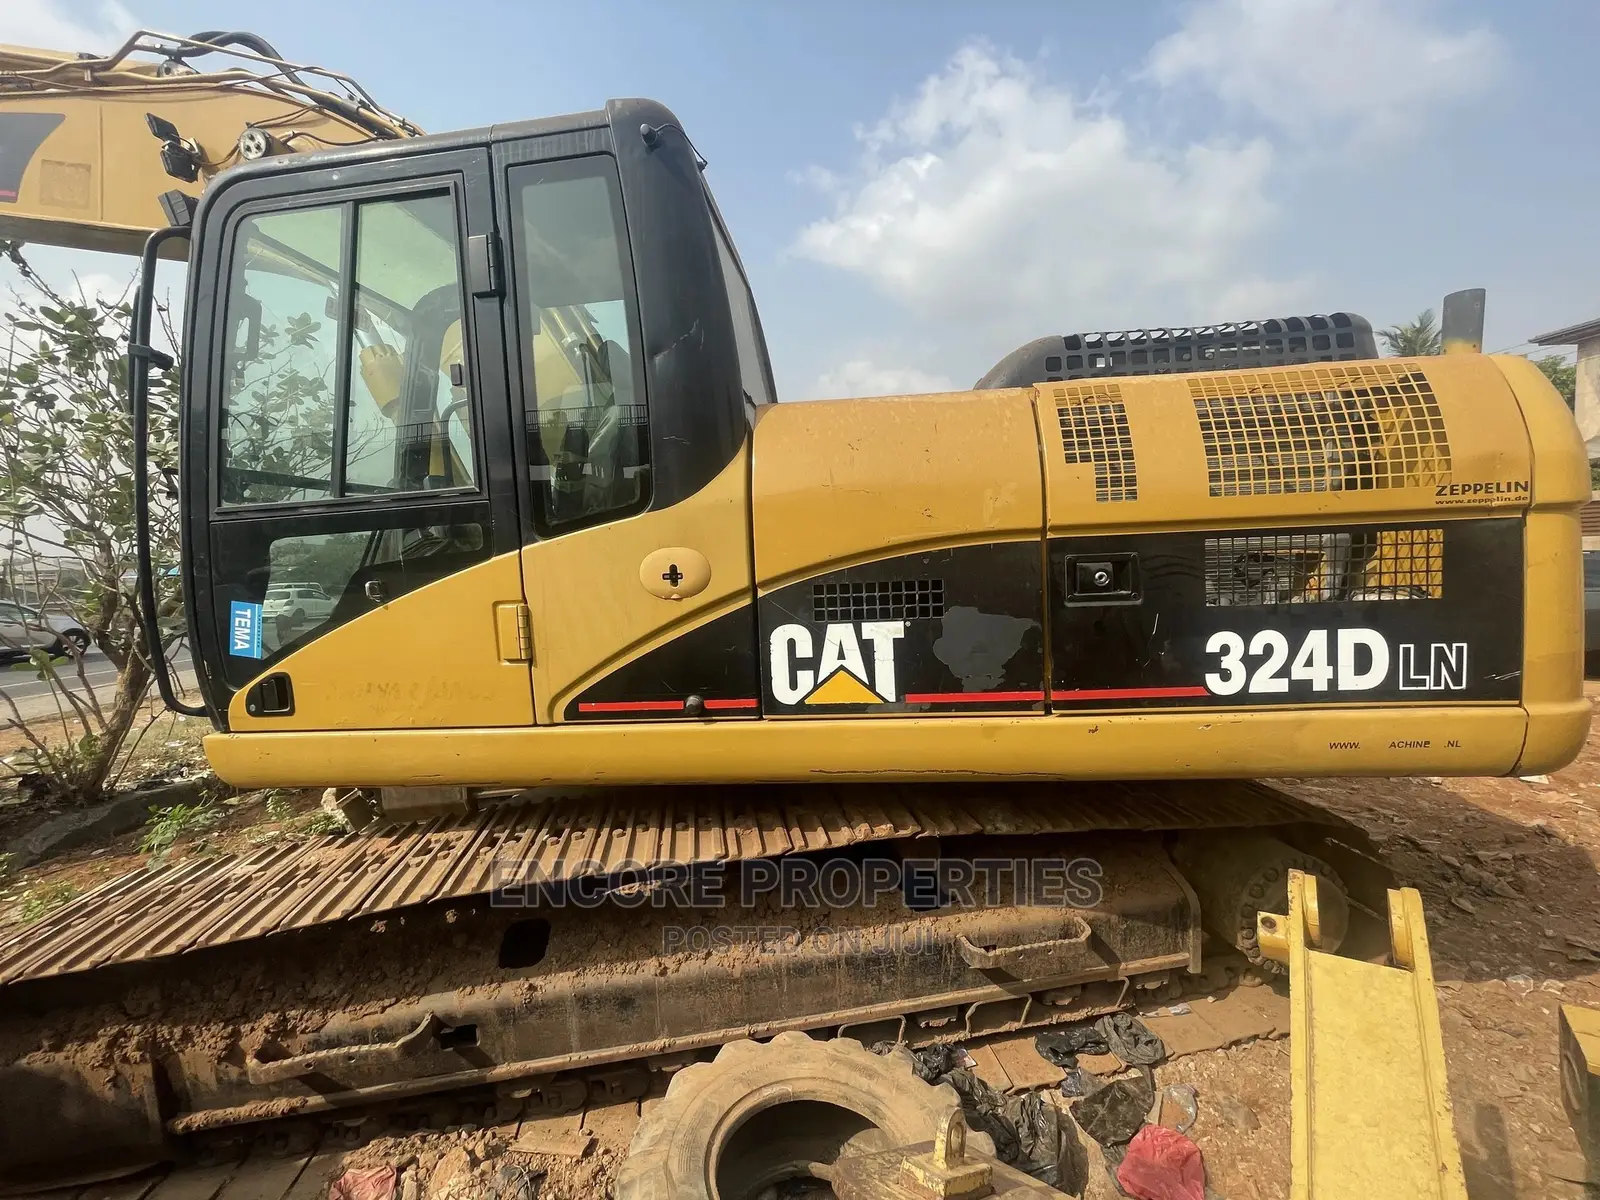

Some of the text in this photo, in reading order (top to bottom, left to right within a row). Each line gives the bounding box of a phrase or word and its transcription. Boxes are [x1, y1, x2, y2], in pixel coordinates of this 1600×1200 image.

[1435, 481, 1529, 496] ZEPPELIN
[1435, 495, 1528, 505] www.zeppelin.de
[234, 608, 251, 650] TEMA
[770, 621, 905, 705] CAT
[1205, 628, 1467, 695] 324D LN
